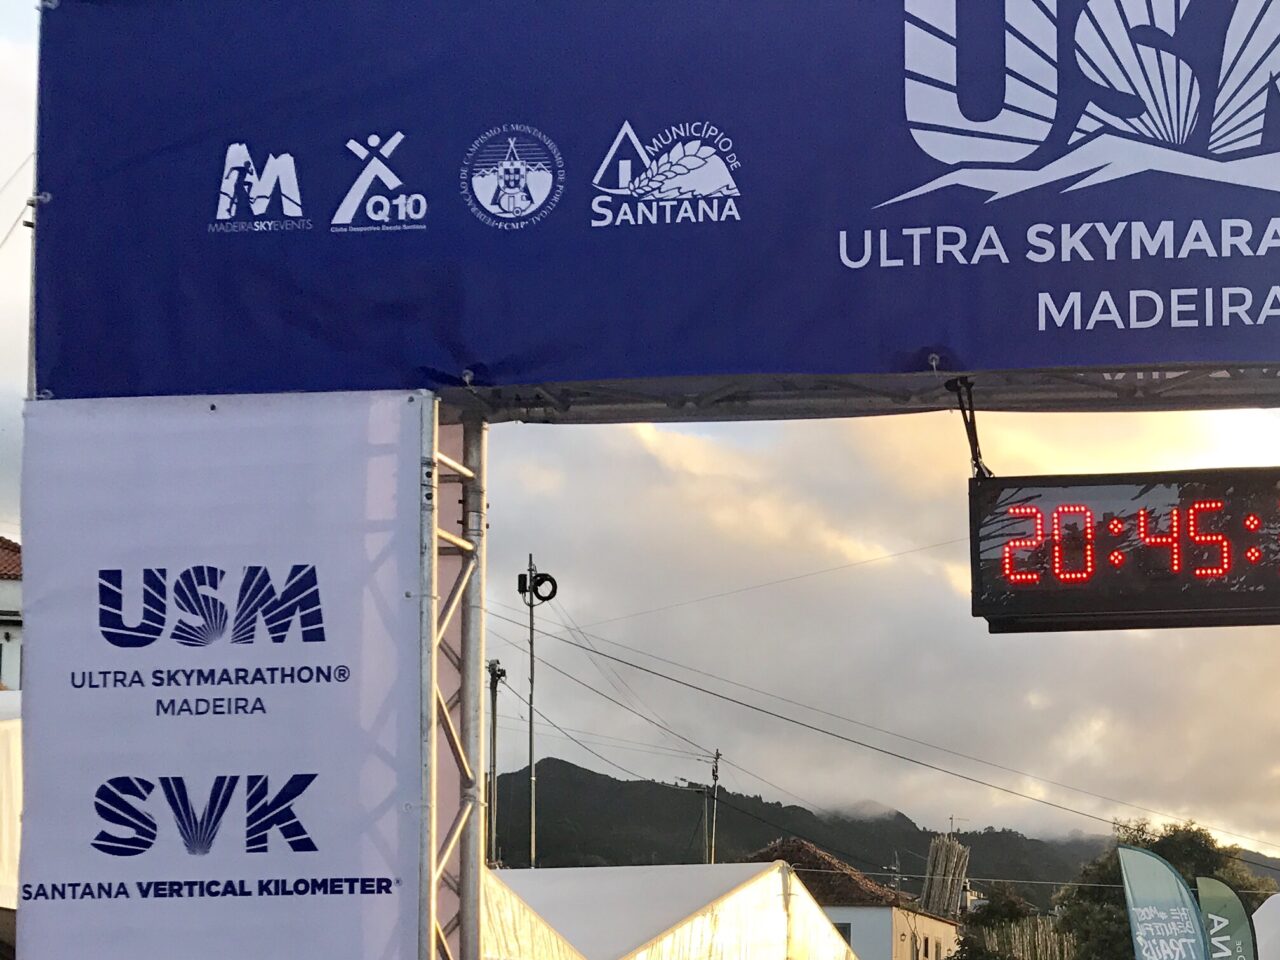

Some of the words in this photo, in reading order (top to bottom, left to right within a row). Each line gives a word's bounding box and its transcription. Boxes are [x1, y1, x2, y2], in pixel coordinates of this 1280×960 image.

[644, 121, 732, 156] MUNICÍPIO
[366, 194, 427, 222] Q10
[591, 195, 741, 227] SANTANA
[839, 226, 1009, 270] ULTRA
[98, 564, 326, 648] USM
[70, 670, 144, 689] ULTRA
[155, 698, 266, 716] MADEIRA
[90, 773, 319, 856] SVK
[22, 882, 129, 901] SANTANA
[136, 880, 252, 898] VERTICAL
